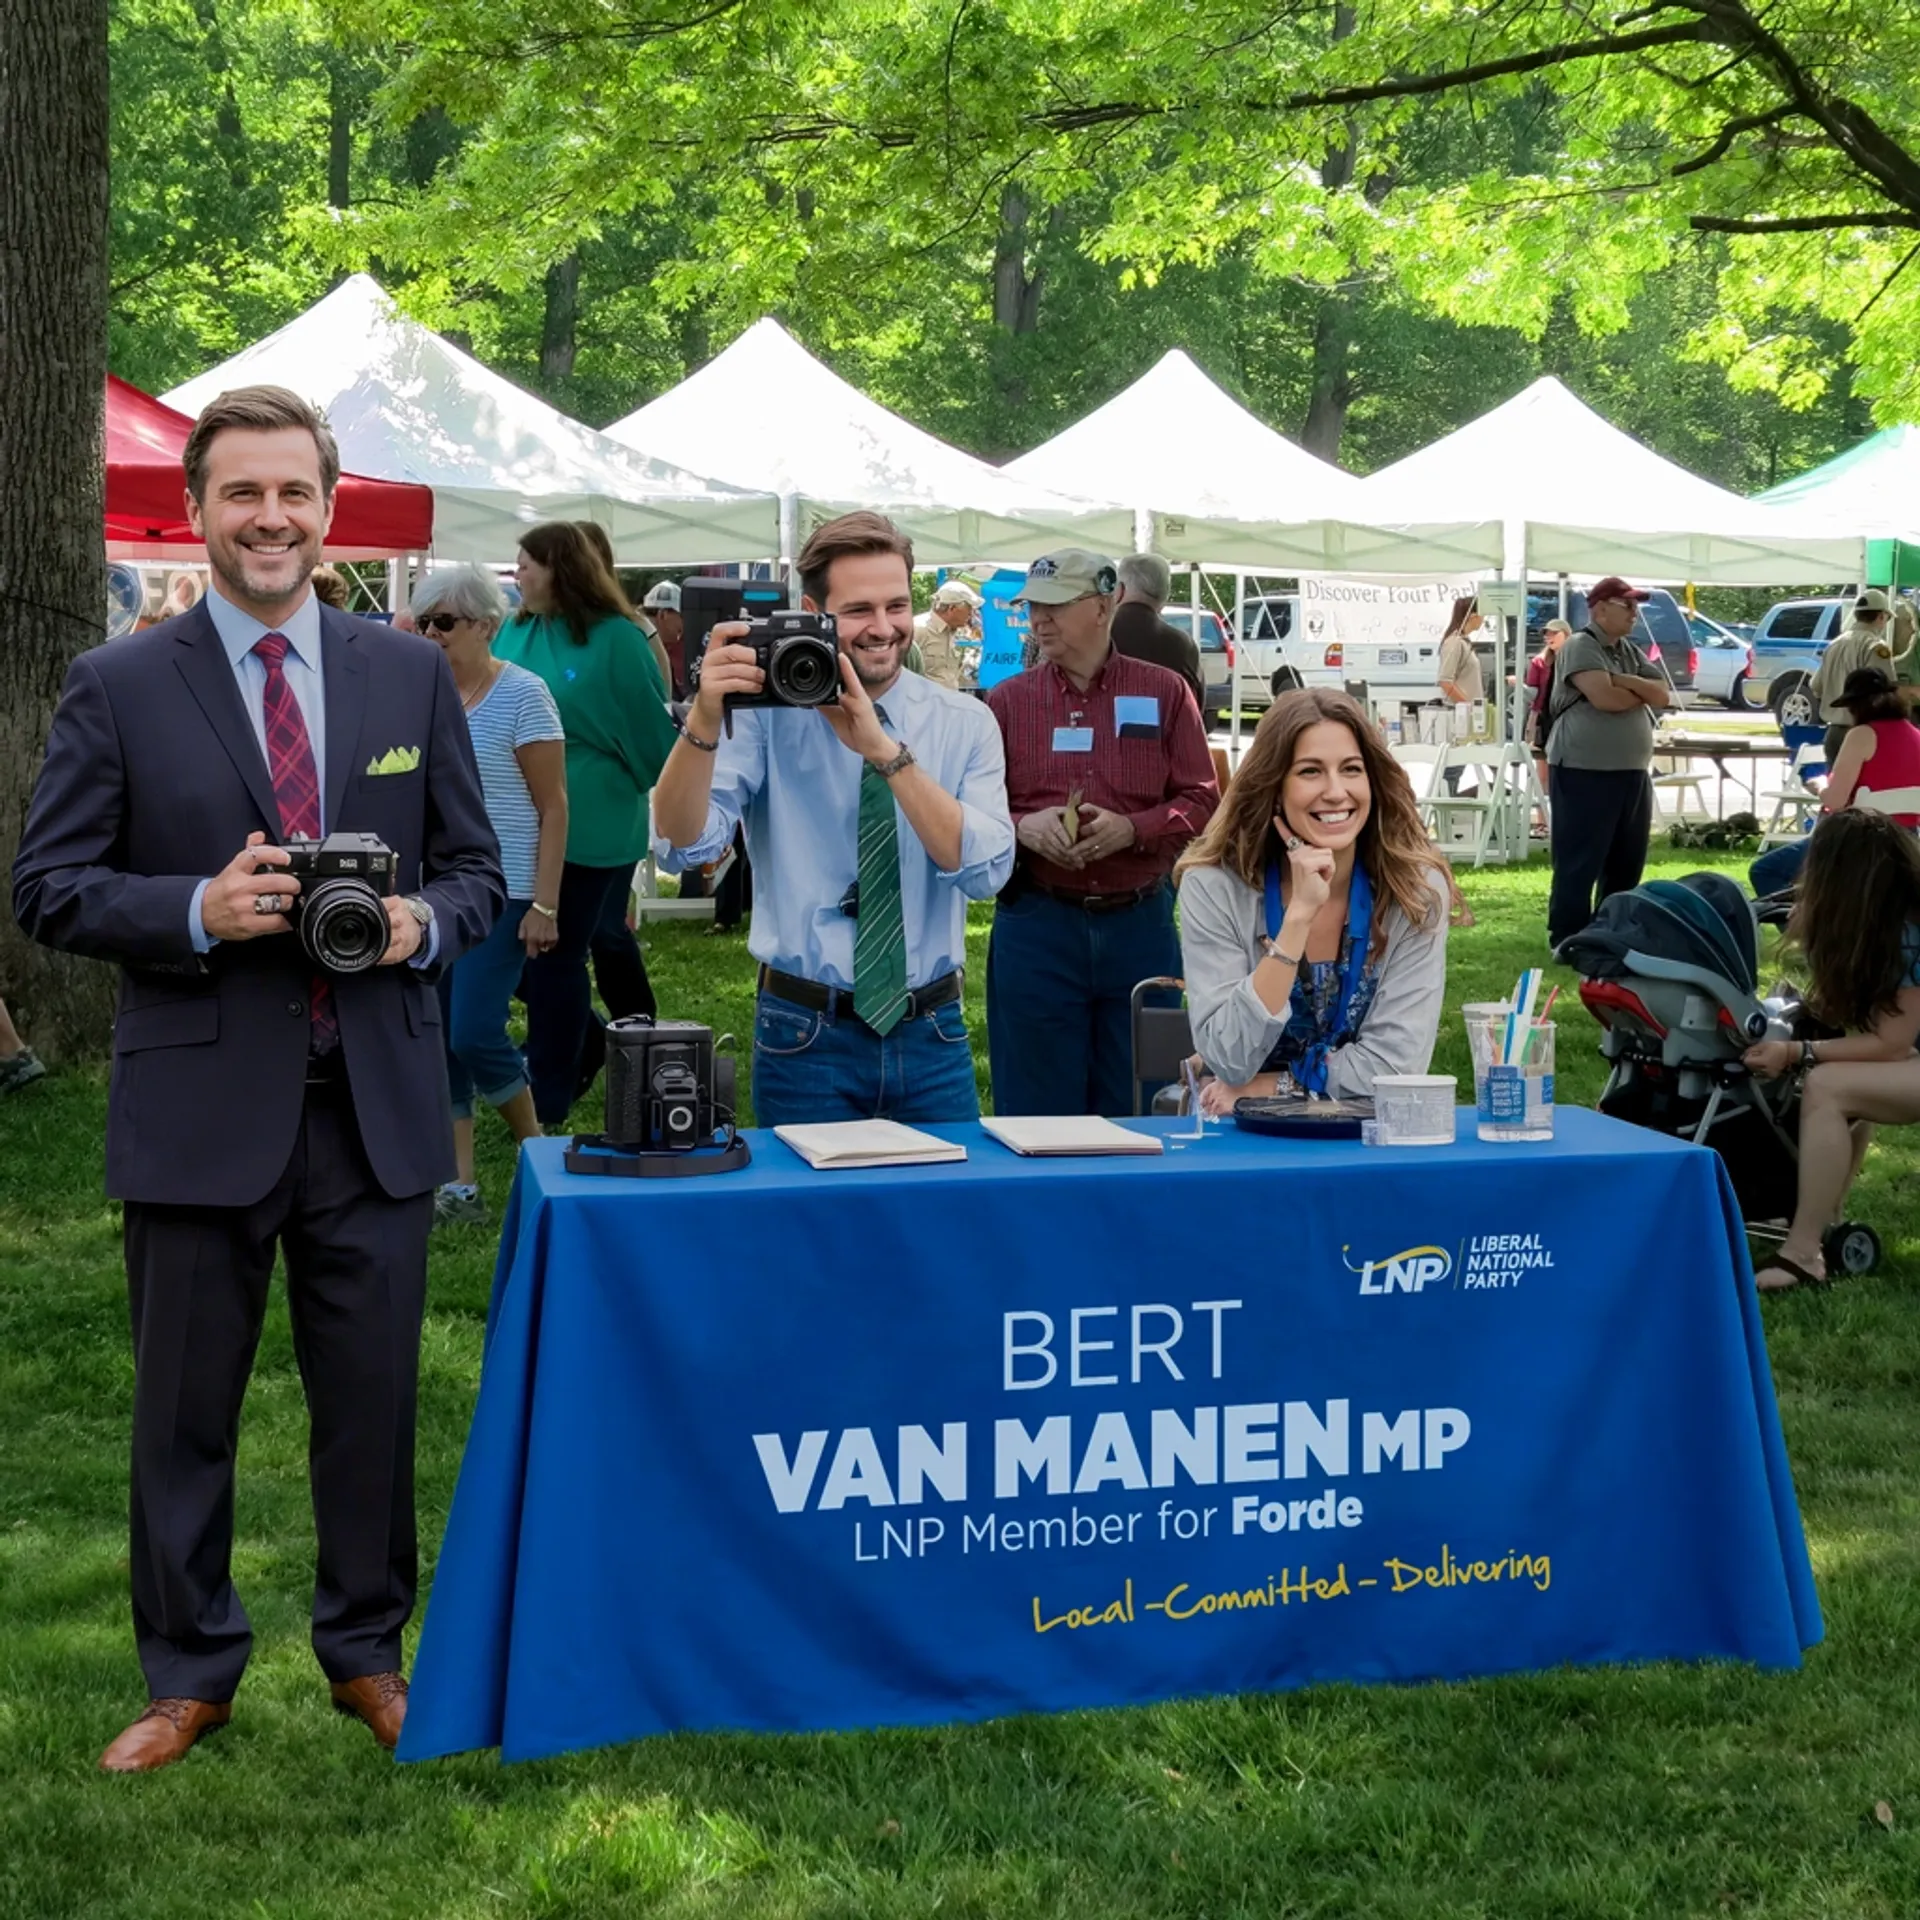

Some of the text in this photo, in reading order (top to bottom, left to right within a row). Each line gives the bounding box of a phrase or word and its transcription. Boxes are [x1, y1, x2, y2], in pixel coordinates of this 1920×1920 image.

[1306, 579, 1381, 603] Discover
[984, 652, 1023, 665] FAIRF
[1470, 1233, 1544, 1253] LIBERAL
[1358, 1256, 1446, 1295] LNP
[1467, 1251, 1555, 1271] NATIONAL
[1464, 1271, 1524, 1290] PARTY
[1004, 1299, 1243, 1391] BERT
[752, 1398, 1472, 1513] VAN MANEN MP
[855, 1489, 1364, 1561] LNP Member for Forde
[1033, 1578, 1135, 1633] Local
[1383, 1543, 1552, 1592] Delivering
